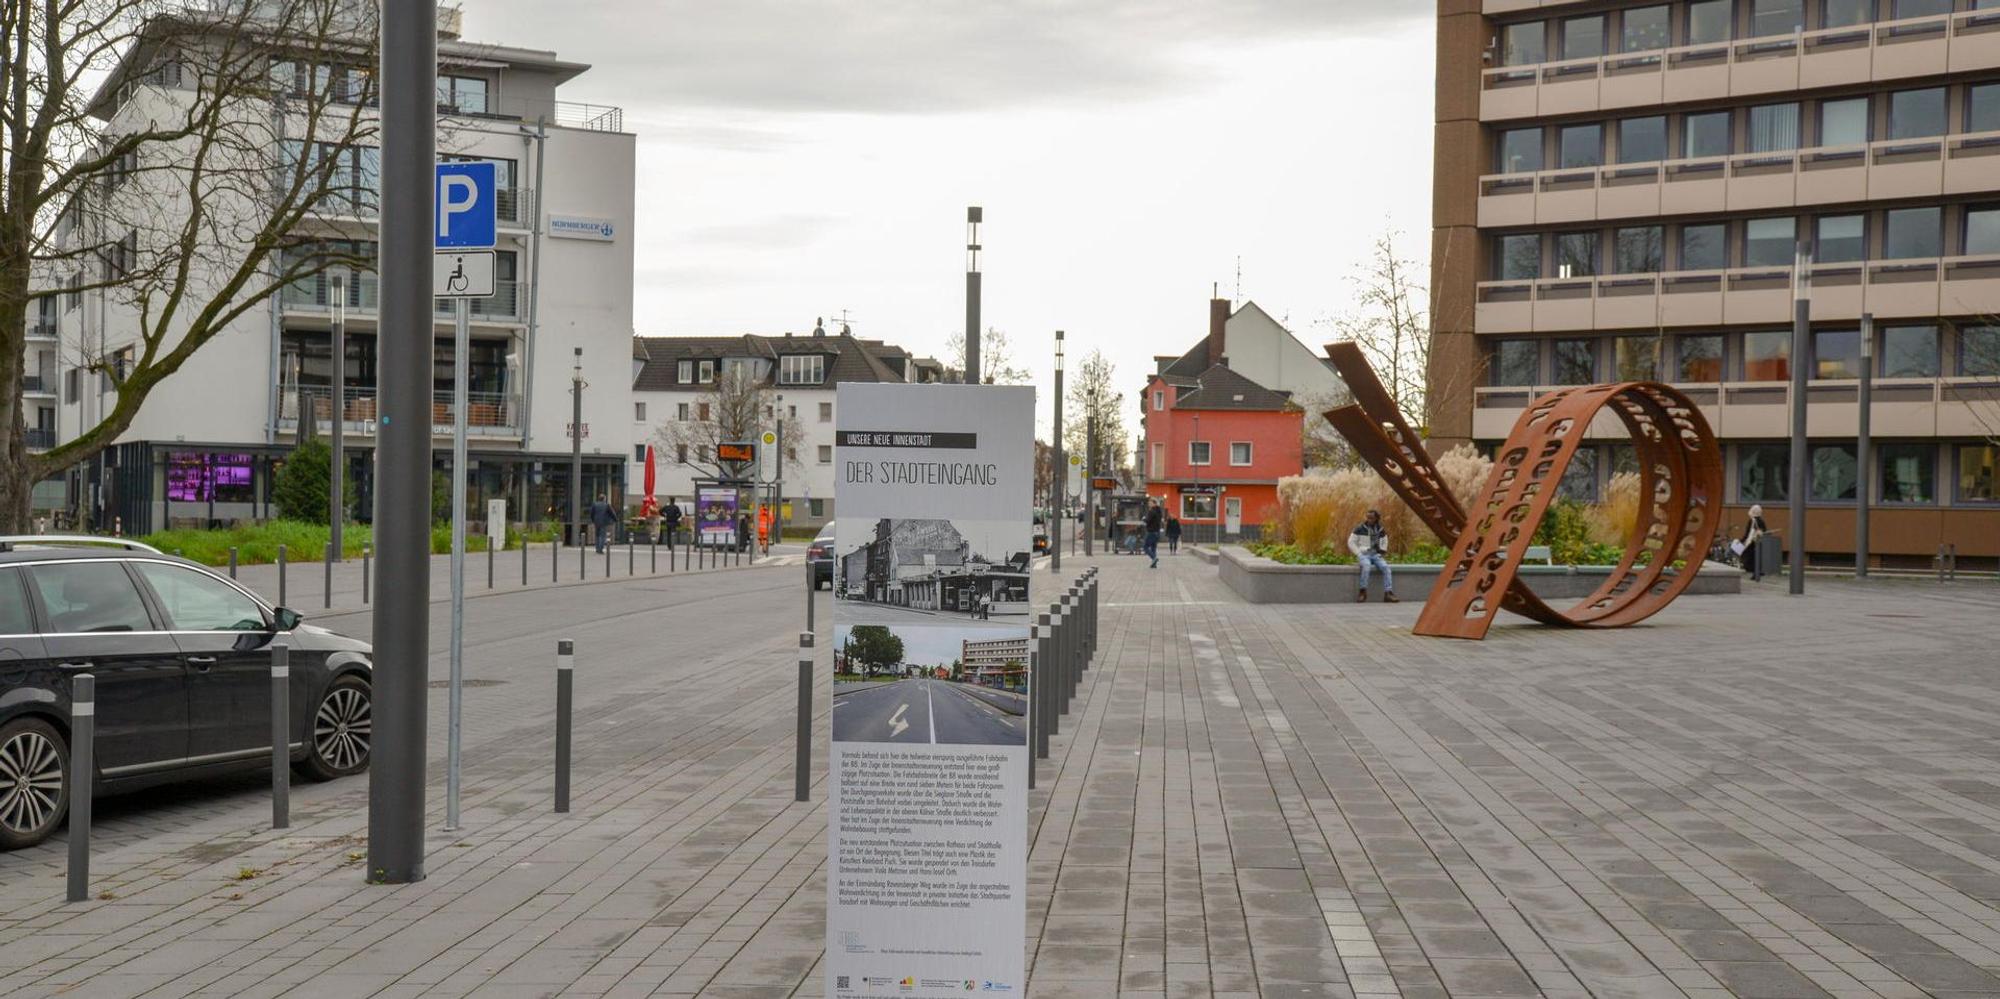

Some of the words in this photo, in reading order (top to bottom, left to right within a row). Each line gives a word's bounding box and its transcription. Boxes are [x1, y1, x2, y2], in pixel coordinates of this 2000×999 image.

[440, 174, 478, 237] P
[847, 434, 872, 445] UNSERE
[874, 434, 890, 446] NEUE
[892, 434, 932, 446] INNENSTADT
[846, 461, 873, 484] DER
[880, 461, 998, 486] STADTEINGANG
